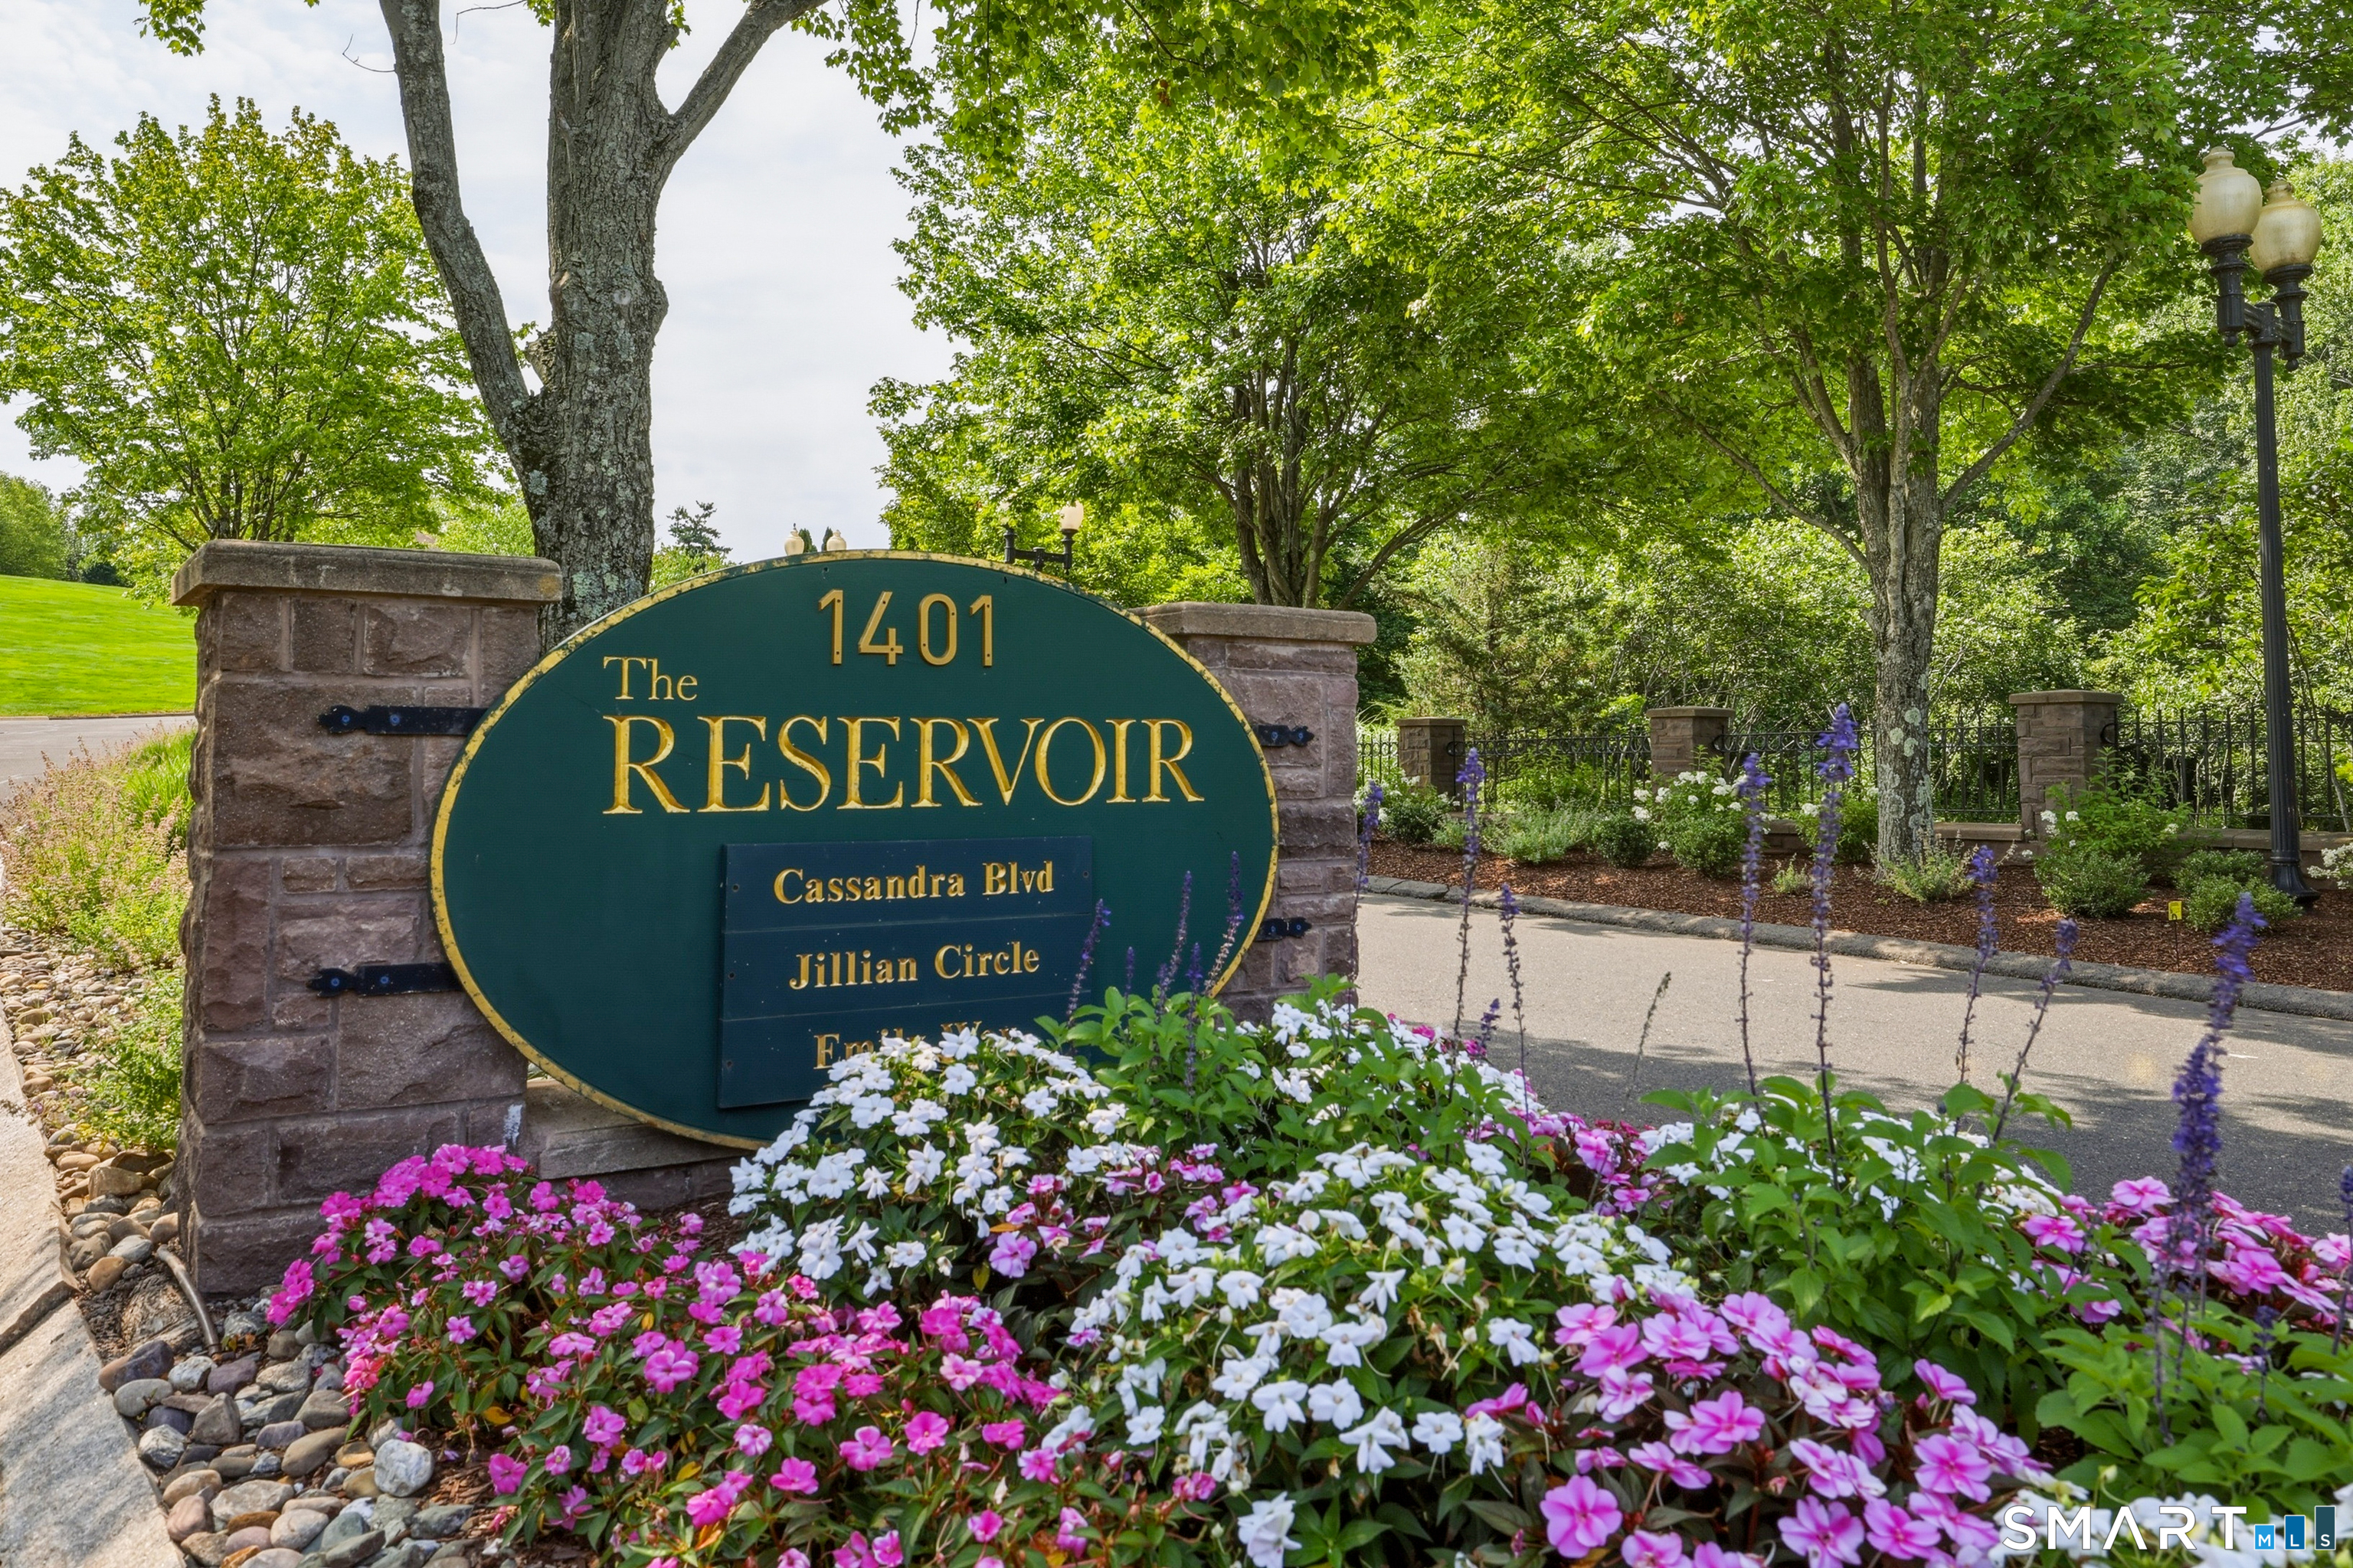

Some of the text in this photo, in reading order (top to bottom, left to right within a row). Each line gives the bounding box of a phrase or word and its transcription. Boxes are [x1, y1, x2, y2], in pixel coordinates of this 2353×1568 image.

[818, 588, 993, 666] 1401
[603, 656, 699, 701] The
[602, 715, 1205, 814] RESERVOIR
[773, 860, 1055, 905] Cassandra Blvd
[789, 941, 1039, 990] Jillian Circle
